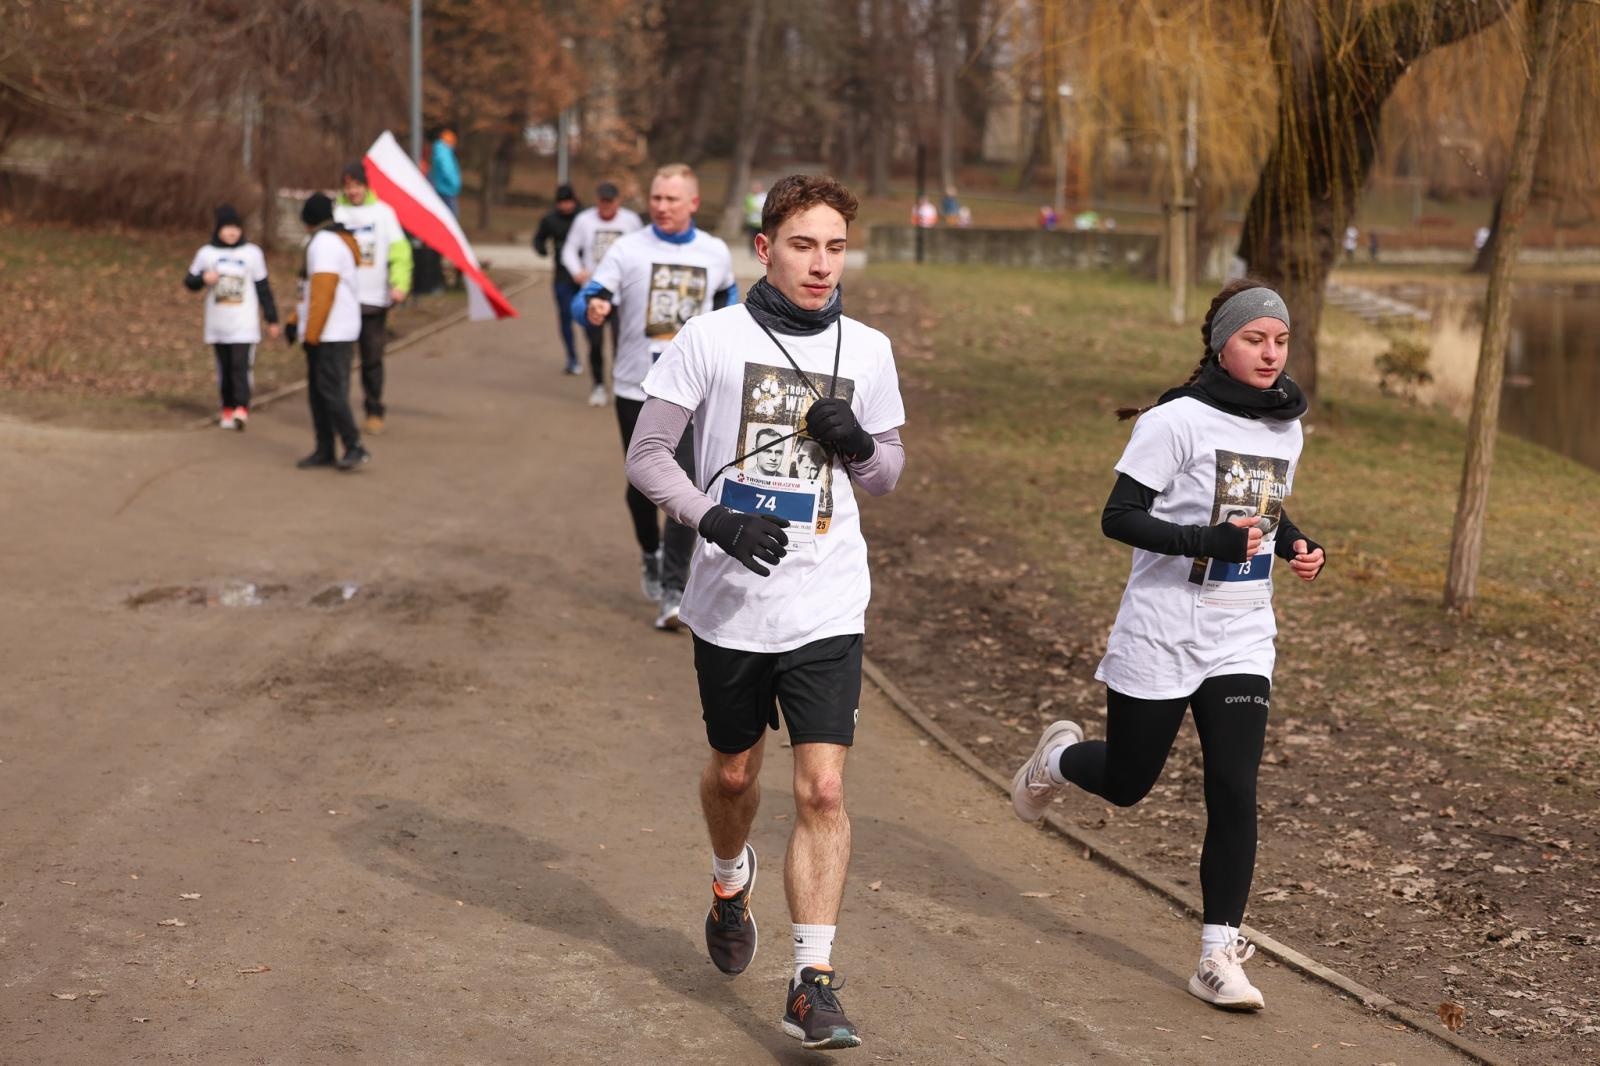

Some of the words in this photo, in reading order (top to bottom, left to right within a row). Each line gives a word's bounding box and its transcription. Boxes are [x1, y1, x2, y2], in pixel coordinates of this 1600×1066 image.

[1263, 299, 1276, 307] 4F
[755, 493, 777, 512] 74
[1238, 560, 1252, 575] 73
[1224, 695, 1251, 704] GYM
